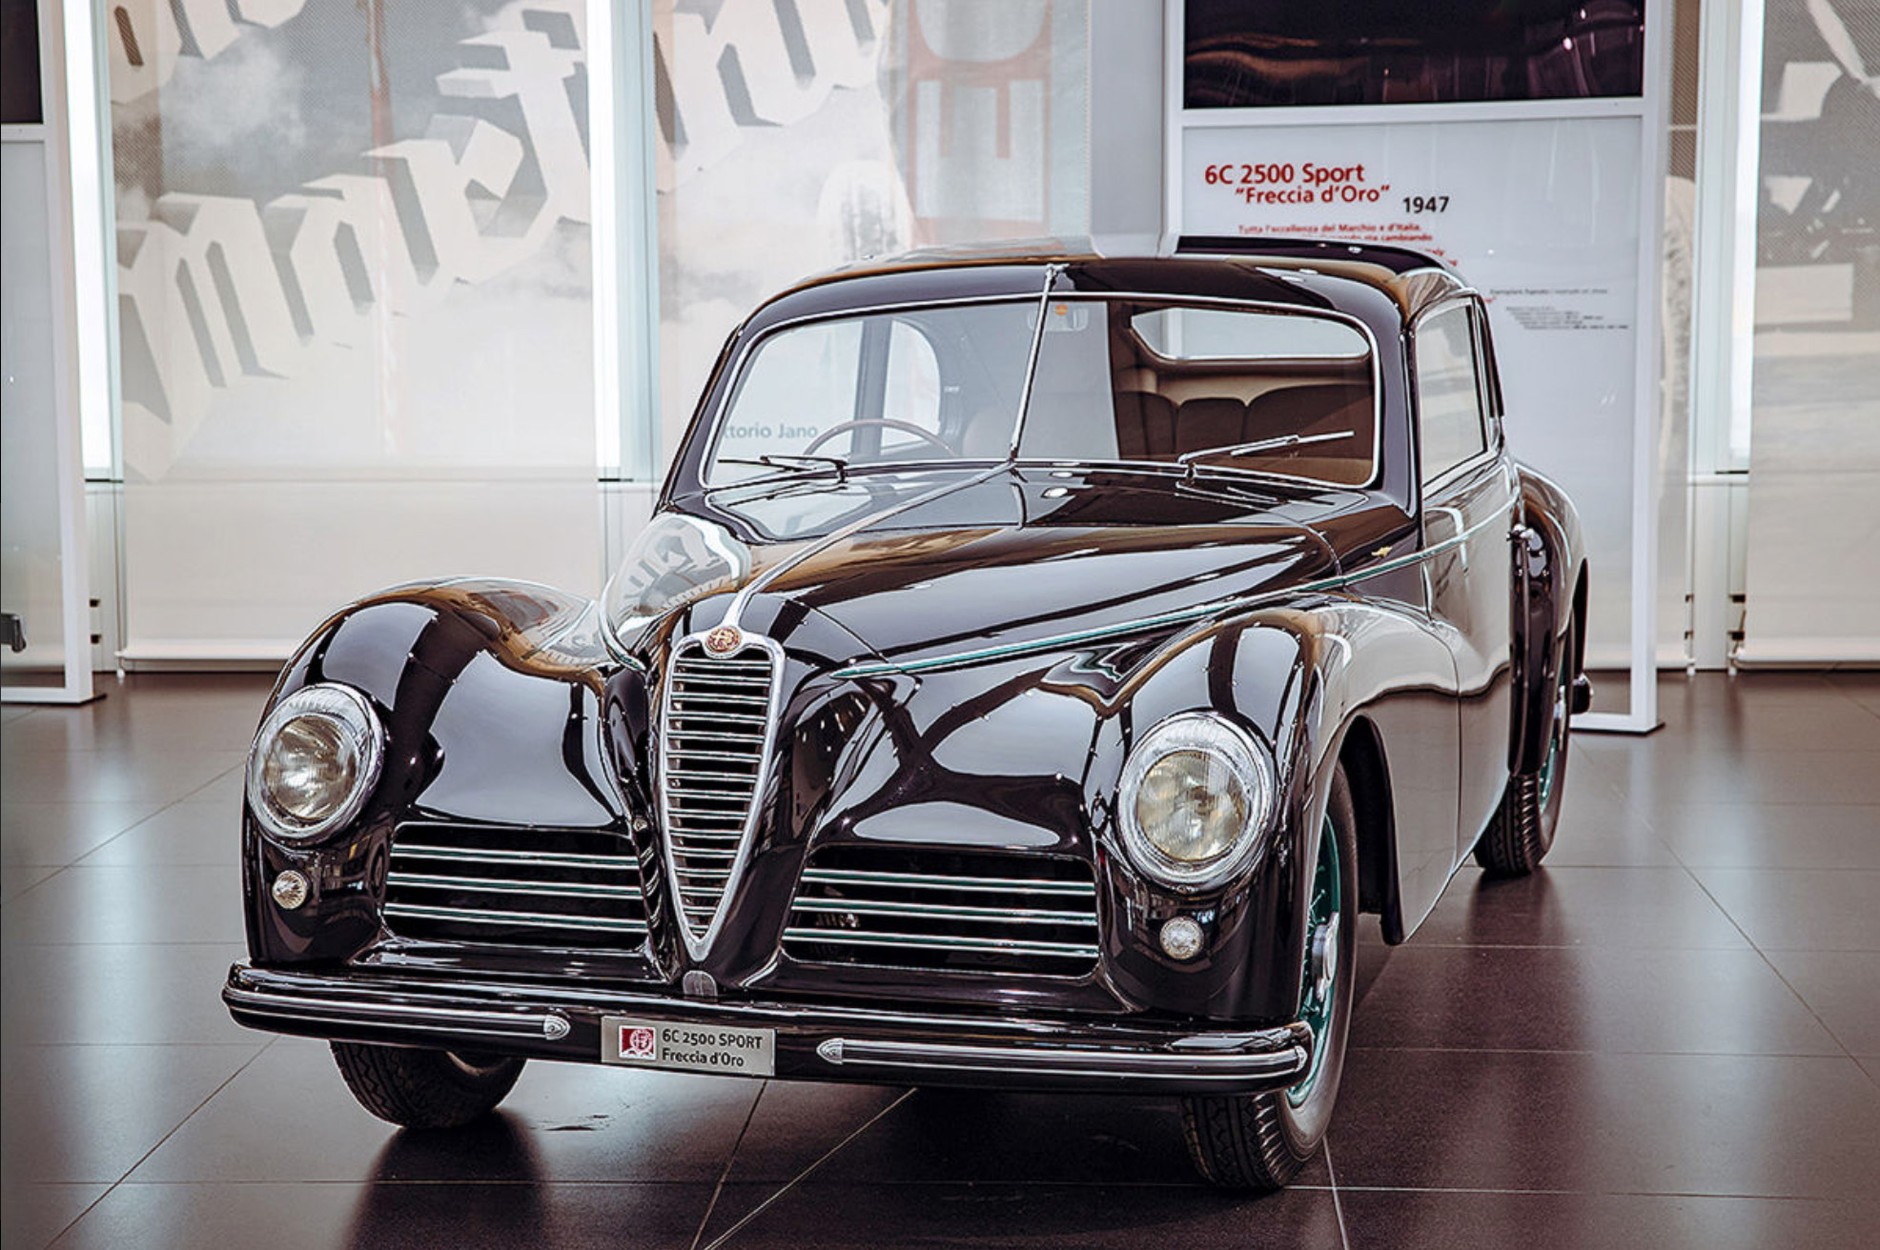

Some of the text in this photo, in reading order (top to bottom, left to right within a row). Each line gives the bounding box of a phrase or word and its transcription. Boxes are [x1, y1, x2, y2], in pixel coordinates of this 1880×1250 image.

[1204, 163, 1366, 188] 6C 2500 Sport
[1403, 196, 1450, 214] 1947
[1322, 223, 1336, 233] del
[1338, 223, 1377, 232] Marchio
[778, 423, 819, 439] Jano
[662, 1028, 764, 1050] 6C 2500 SPORT
[661, 1047, 745, 1067] Freccia d'Oro
